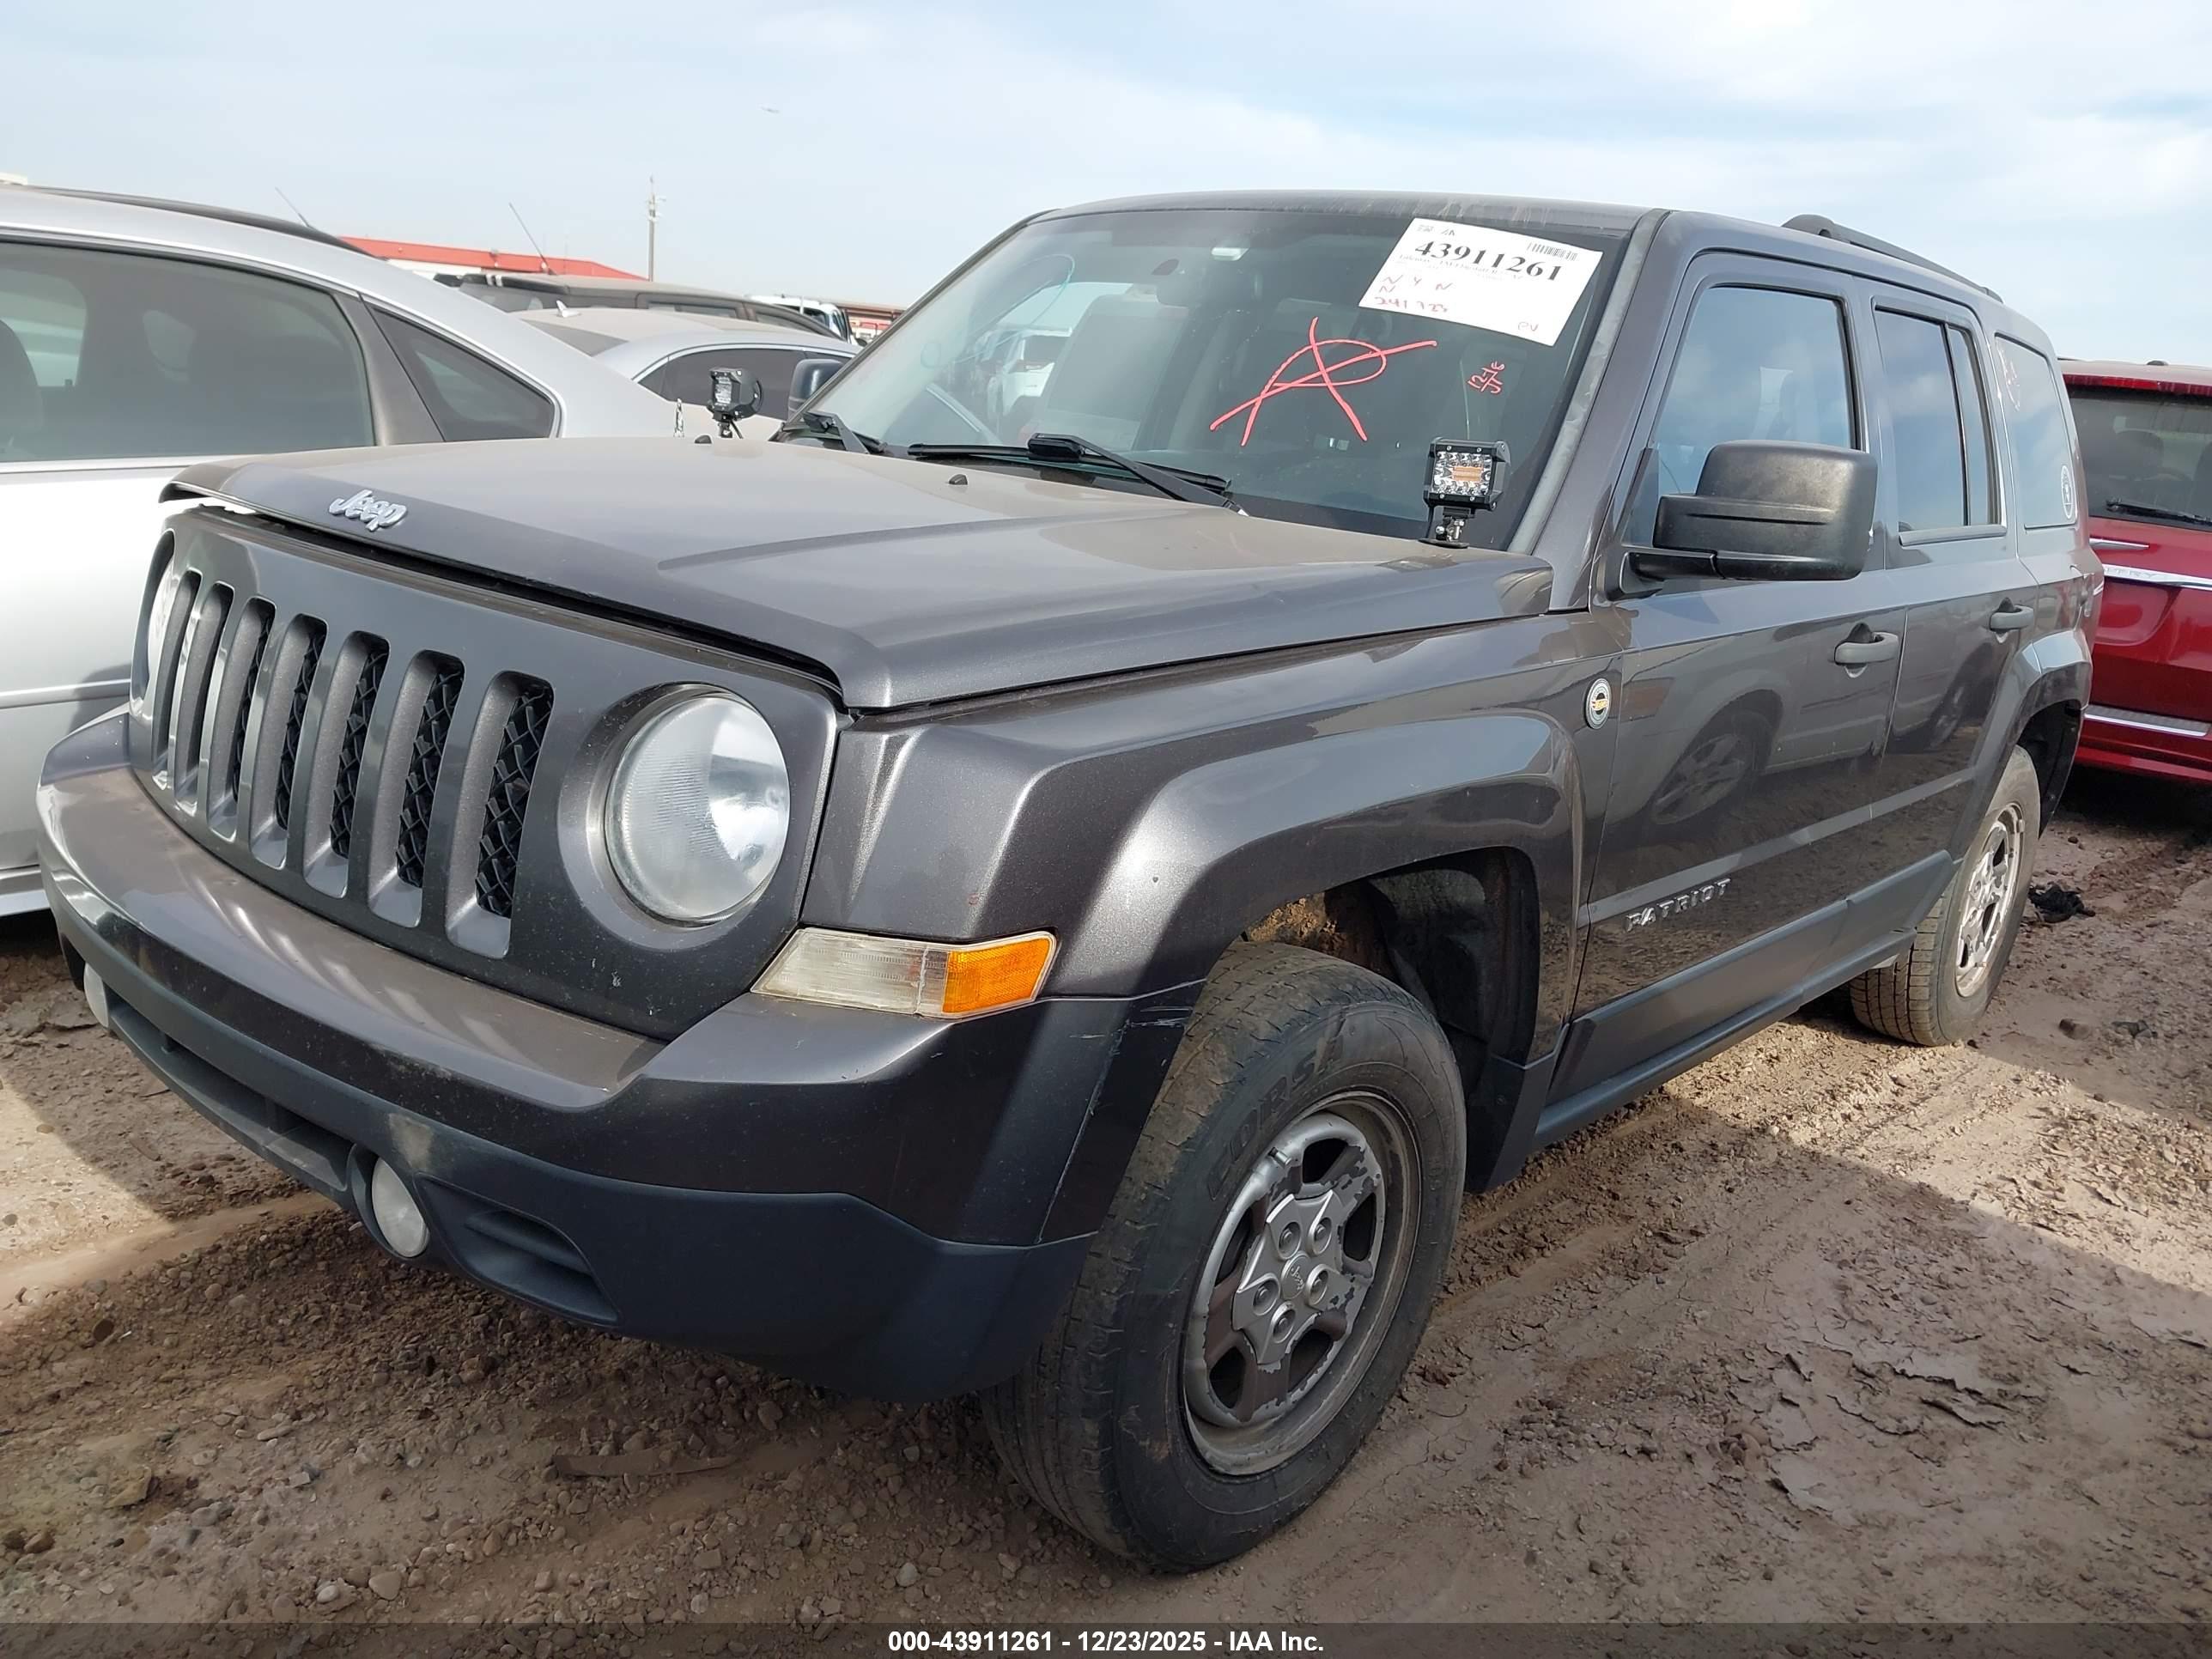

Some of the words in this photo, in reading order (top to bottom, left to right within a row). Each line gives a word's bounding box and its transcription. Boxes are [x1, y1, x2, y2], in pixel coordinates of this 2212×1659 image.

[1414, 240, 1562, 281] 43911261
[329, 489, 408, 532] Jeep
[1626, 878, 1731, 933] PATRIOT
